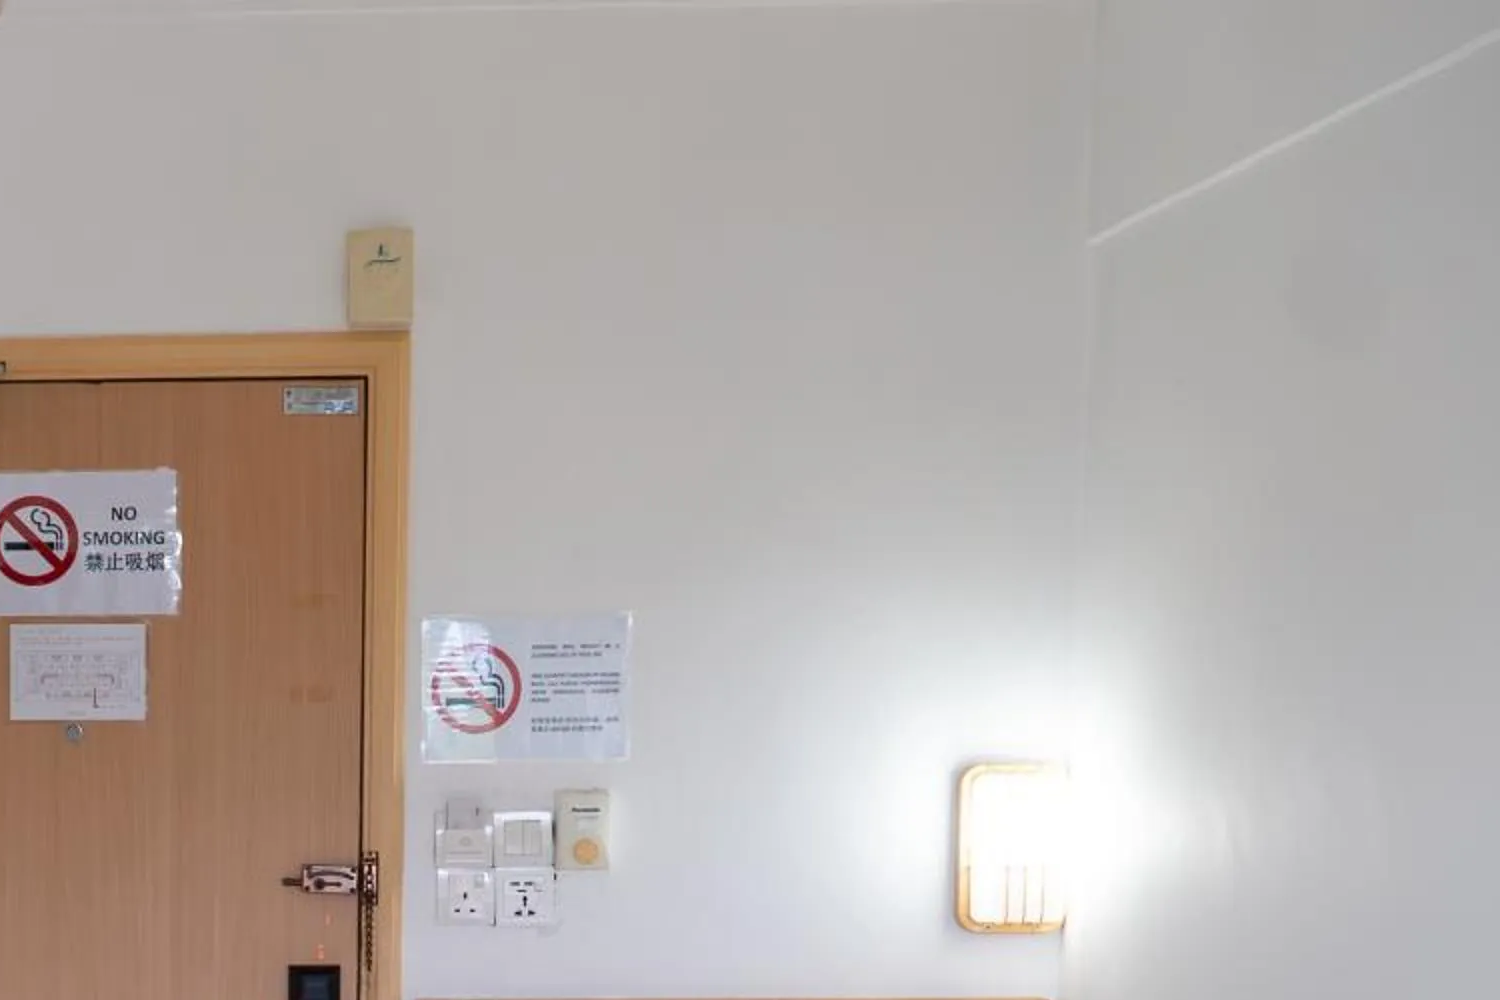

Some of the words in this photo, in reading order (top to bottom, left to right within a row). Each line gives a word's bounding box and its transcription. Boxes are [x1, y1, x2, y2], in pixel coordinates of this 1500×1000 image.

[111, 506, 137, 521] NO
[83, 531, 165, 546] SMOKING
[84, 552, 165, 572] 禁止吸烟
